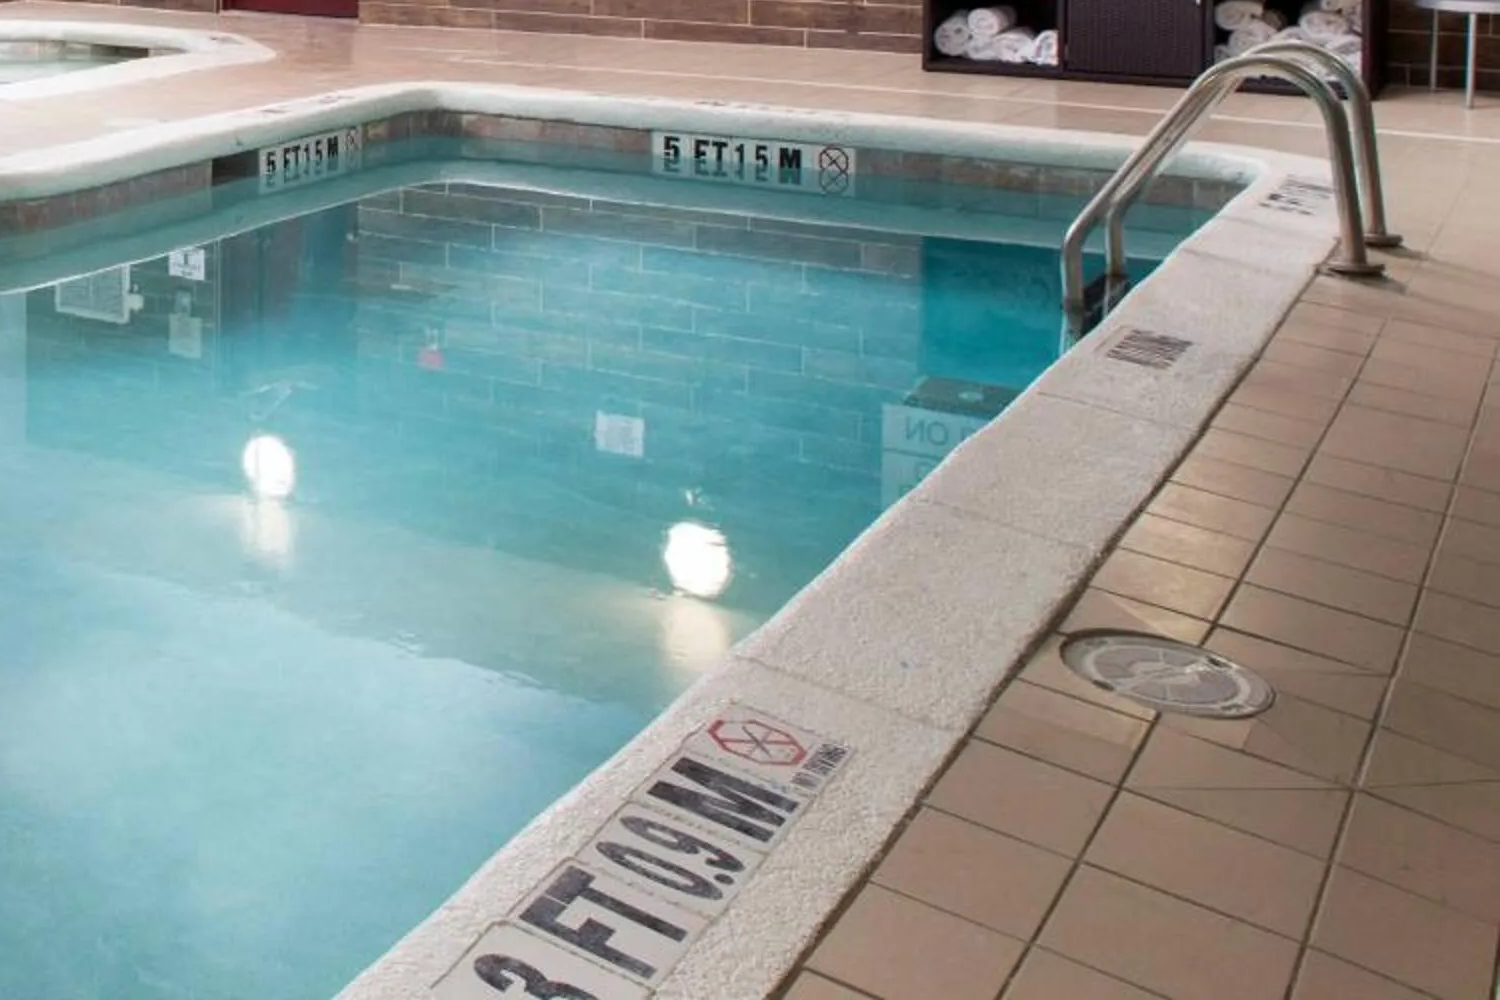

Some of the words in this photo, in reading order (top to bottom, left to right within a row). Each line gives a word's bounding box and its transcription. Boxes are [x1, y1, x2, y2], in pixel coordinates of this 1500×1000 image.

[664, 136, 681, 159] 5
[779, 147, 802, 169] M
[647, 757, 799, 844] M
[595, 816, 745, 901] 0.9
[519, 865, 687, 979] FT
